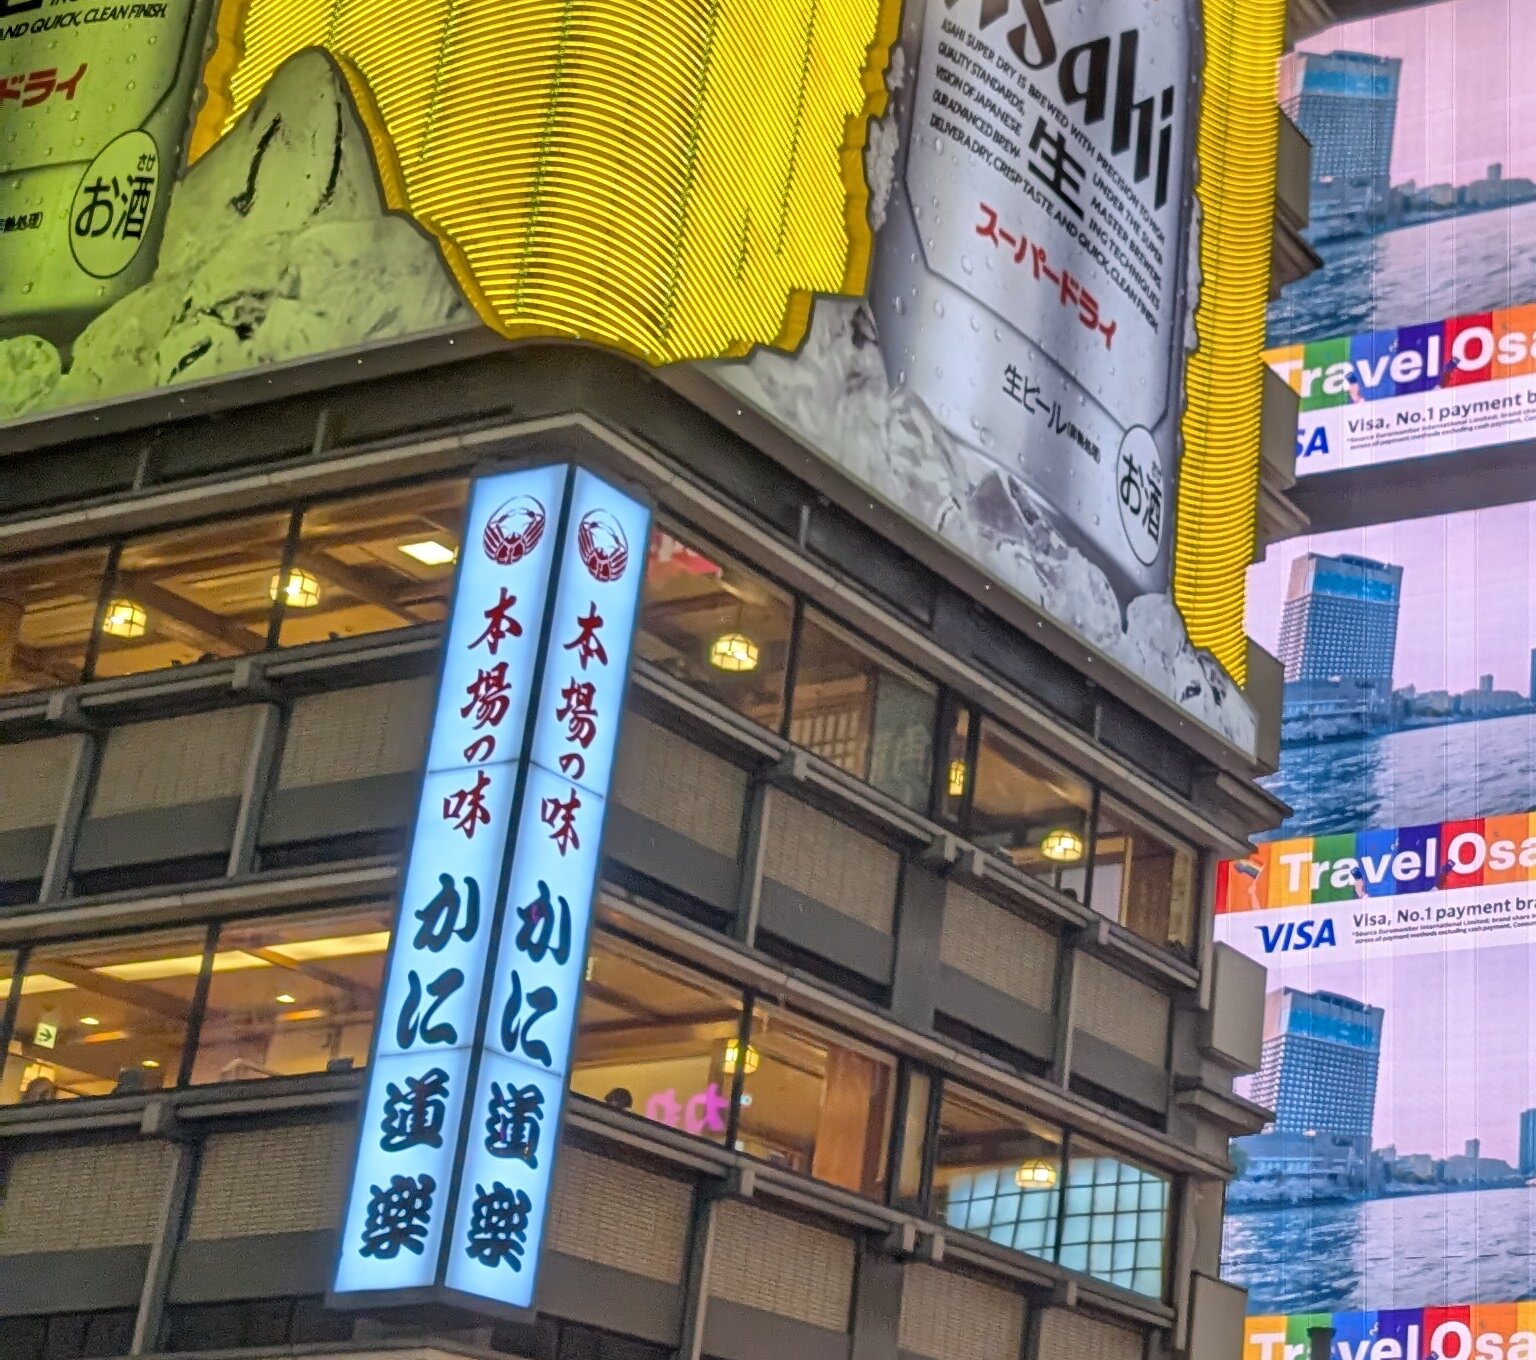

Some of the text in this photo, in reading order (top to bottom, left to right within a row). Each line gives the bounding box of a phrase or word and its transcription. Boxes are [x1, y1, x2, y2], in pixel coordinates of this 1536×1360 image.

[84, 5, 130, 23] CLEAN
[938, 41, 973, 71] QUALITY
[935, 64, 1022, 136] VISION OF JAPANESE
[942, 18, 966, 41] ASAHI
[968, 33, 995, 61] SUPER
[996, 56, 1016, 77] DRY
[1018, 73, 1027, 88] IS
[1029, 84, 1068, 128] BREWED
[1071, 123, 1096, 157] WITH
[1096, 154, 1139, 207] PRECISION
[949, 102, 993, 138] ADVANCED
[138, 154, 155, 171] さけ
[1028, 116, 1087, 221] 生
[75, 174, 154, 240] お酒
[993, 158, 1022, 185] CRISP
[1023, 178, 1054, 216] TASTE
[1053, 212, 1078, 239] AND
[1109, 267, 1139, 308] CLEAN
[1090, 197, 1129, 245] MASTER
[1092, 172, 1141, 234] UNDER THE
[976, 201, 1117, 351] スーパードライ
[1089, 219, 1161, 311] ING TECHNIQUES
[1003, 363, 1066, 434] 生ビール
[1348, 417, 1391, 434] Visa,
[1396, 407, 1435, 427] No.1
[1438, 395, 1523, 422] payment
[1120, 453, 1162, 544] お酒
[443, 586, 524, 841] 本場の味
[540, 600, 609, 857] 本場の味
[1279, 839, 1436, 893] Travel
[1255, 919, 1337, 954] VISA
[1353, 912, 1392, 929] Visa,
[1397, 907, 1433, 924] No.1
[1436, 898, 1512, 922] payment
